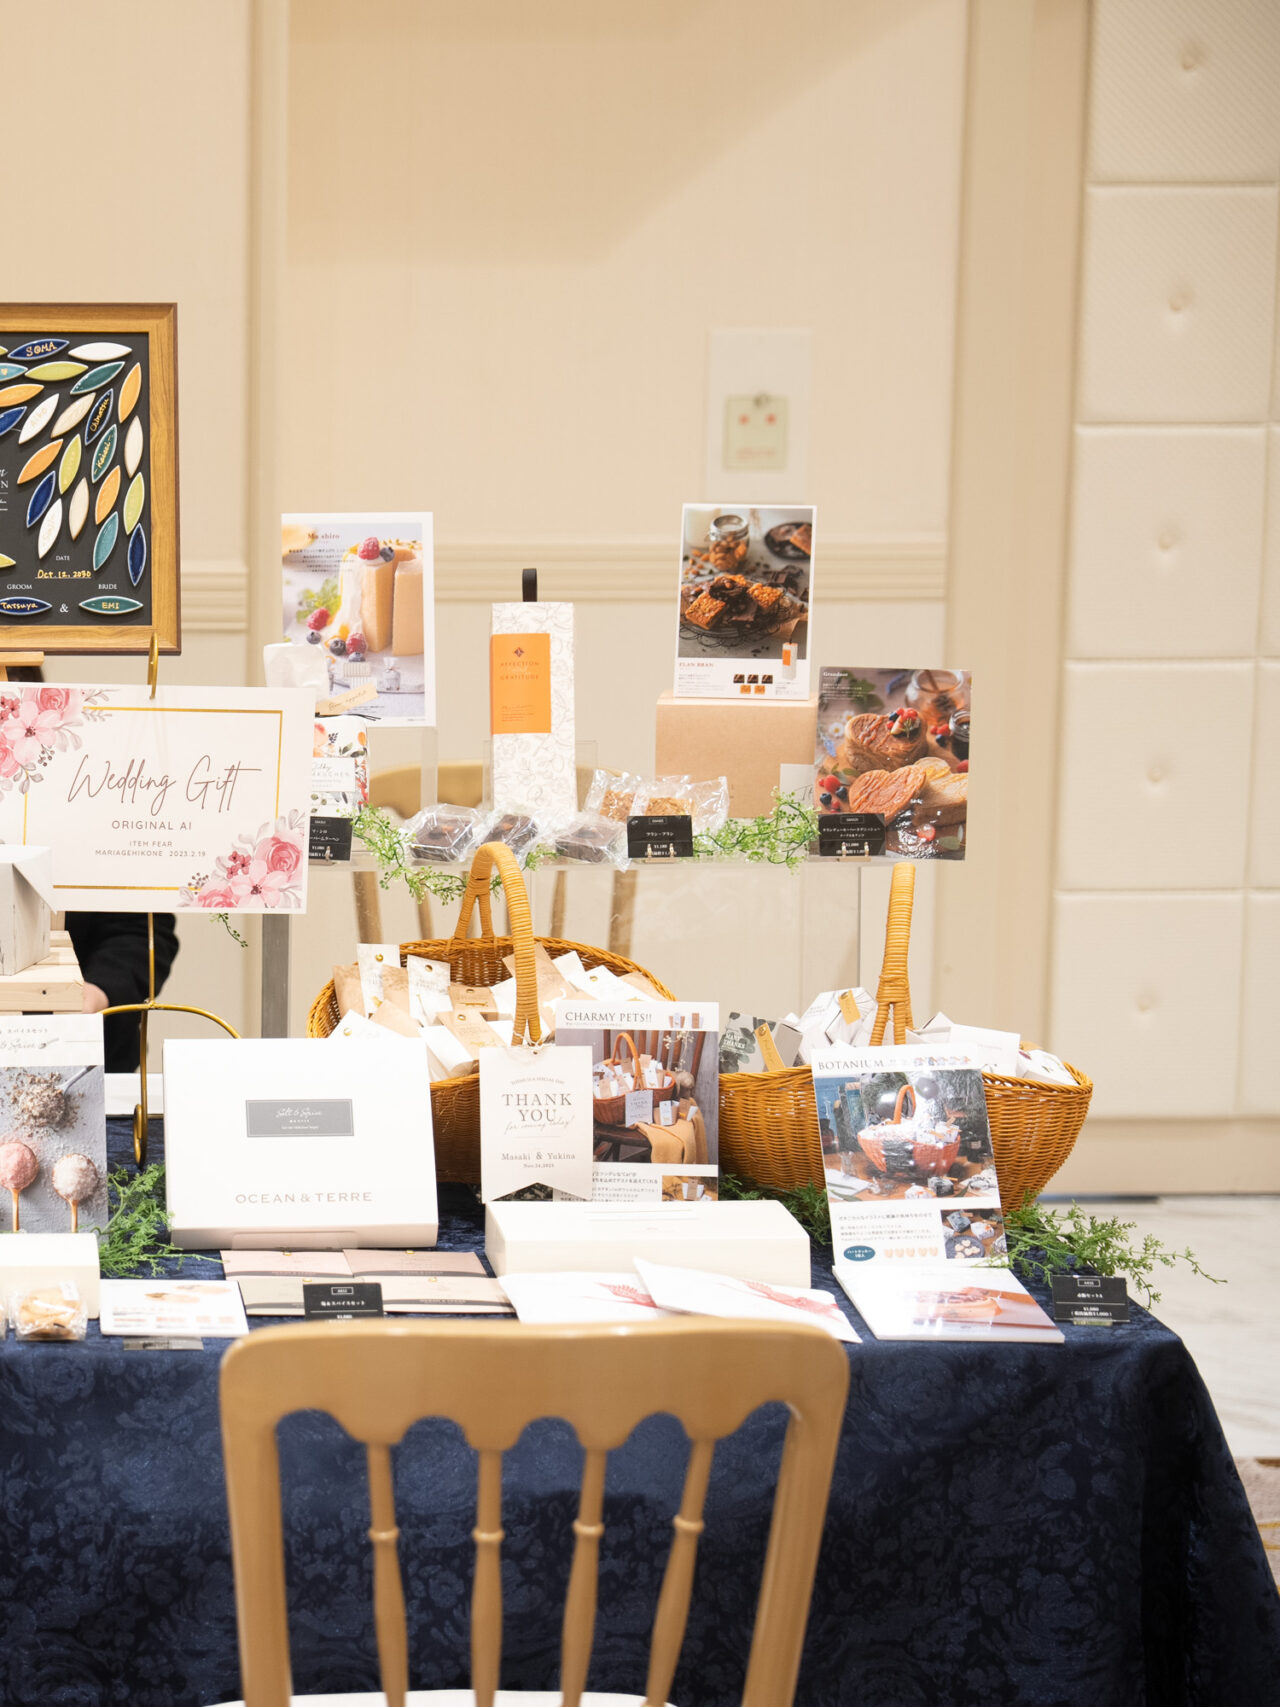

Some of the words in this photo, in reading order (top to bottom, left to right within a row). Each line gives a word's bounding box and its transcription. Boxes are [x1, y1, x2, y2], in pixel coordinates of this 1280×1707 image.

[59, 603, 69, 613] &
[67, 754, 176, 816] Wedding
[186, 755, 262, 813] Gift
[111, 820, 174, 831] ORIGINAL
[180, 821, 193, 830] AI
[95, 849, 163, 857] MARIAGEHIKONE
[565, 1012, 615, 1021] CHARMY
[501, 1093, 572, 1106] THANK
[518, 1109, 557, 1122] YOU
[536, 1151, 543, 1160] &
[235, 1194, 295, 1204] OCEAN
[301, 1193, 310, 1202] &
[315, 1192, 372, 1202] TERRE
